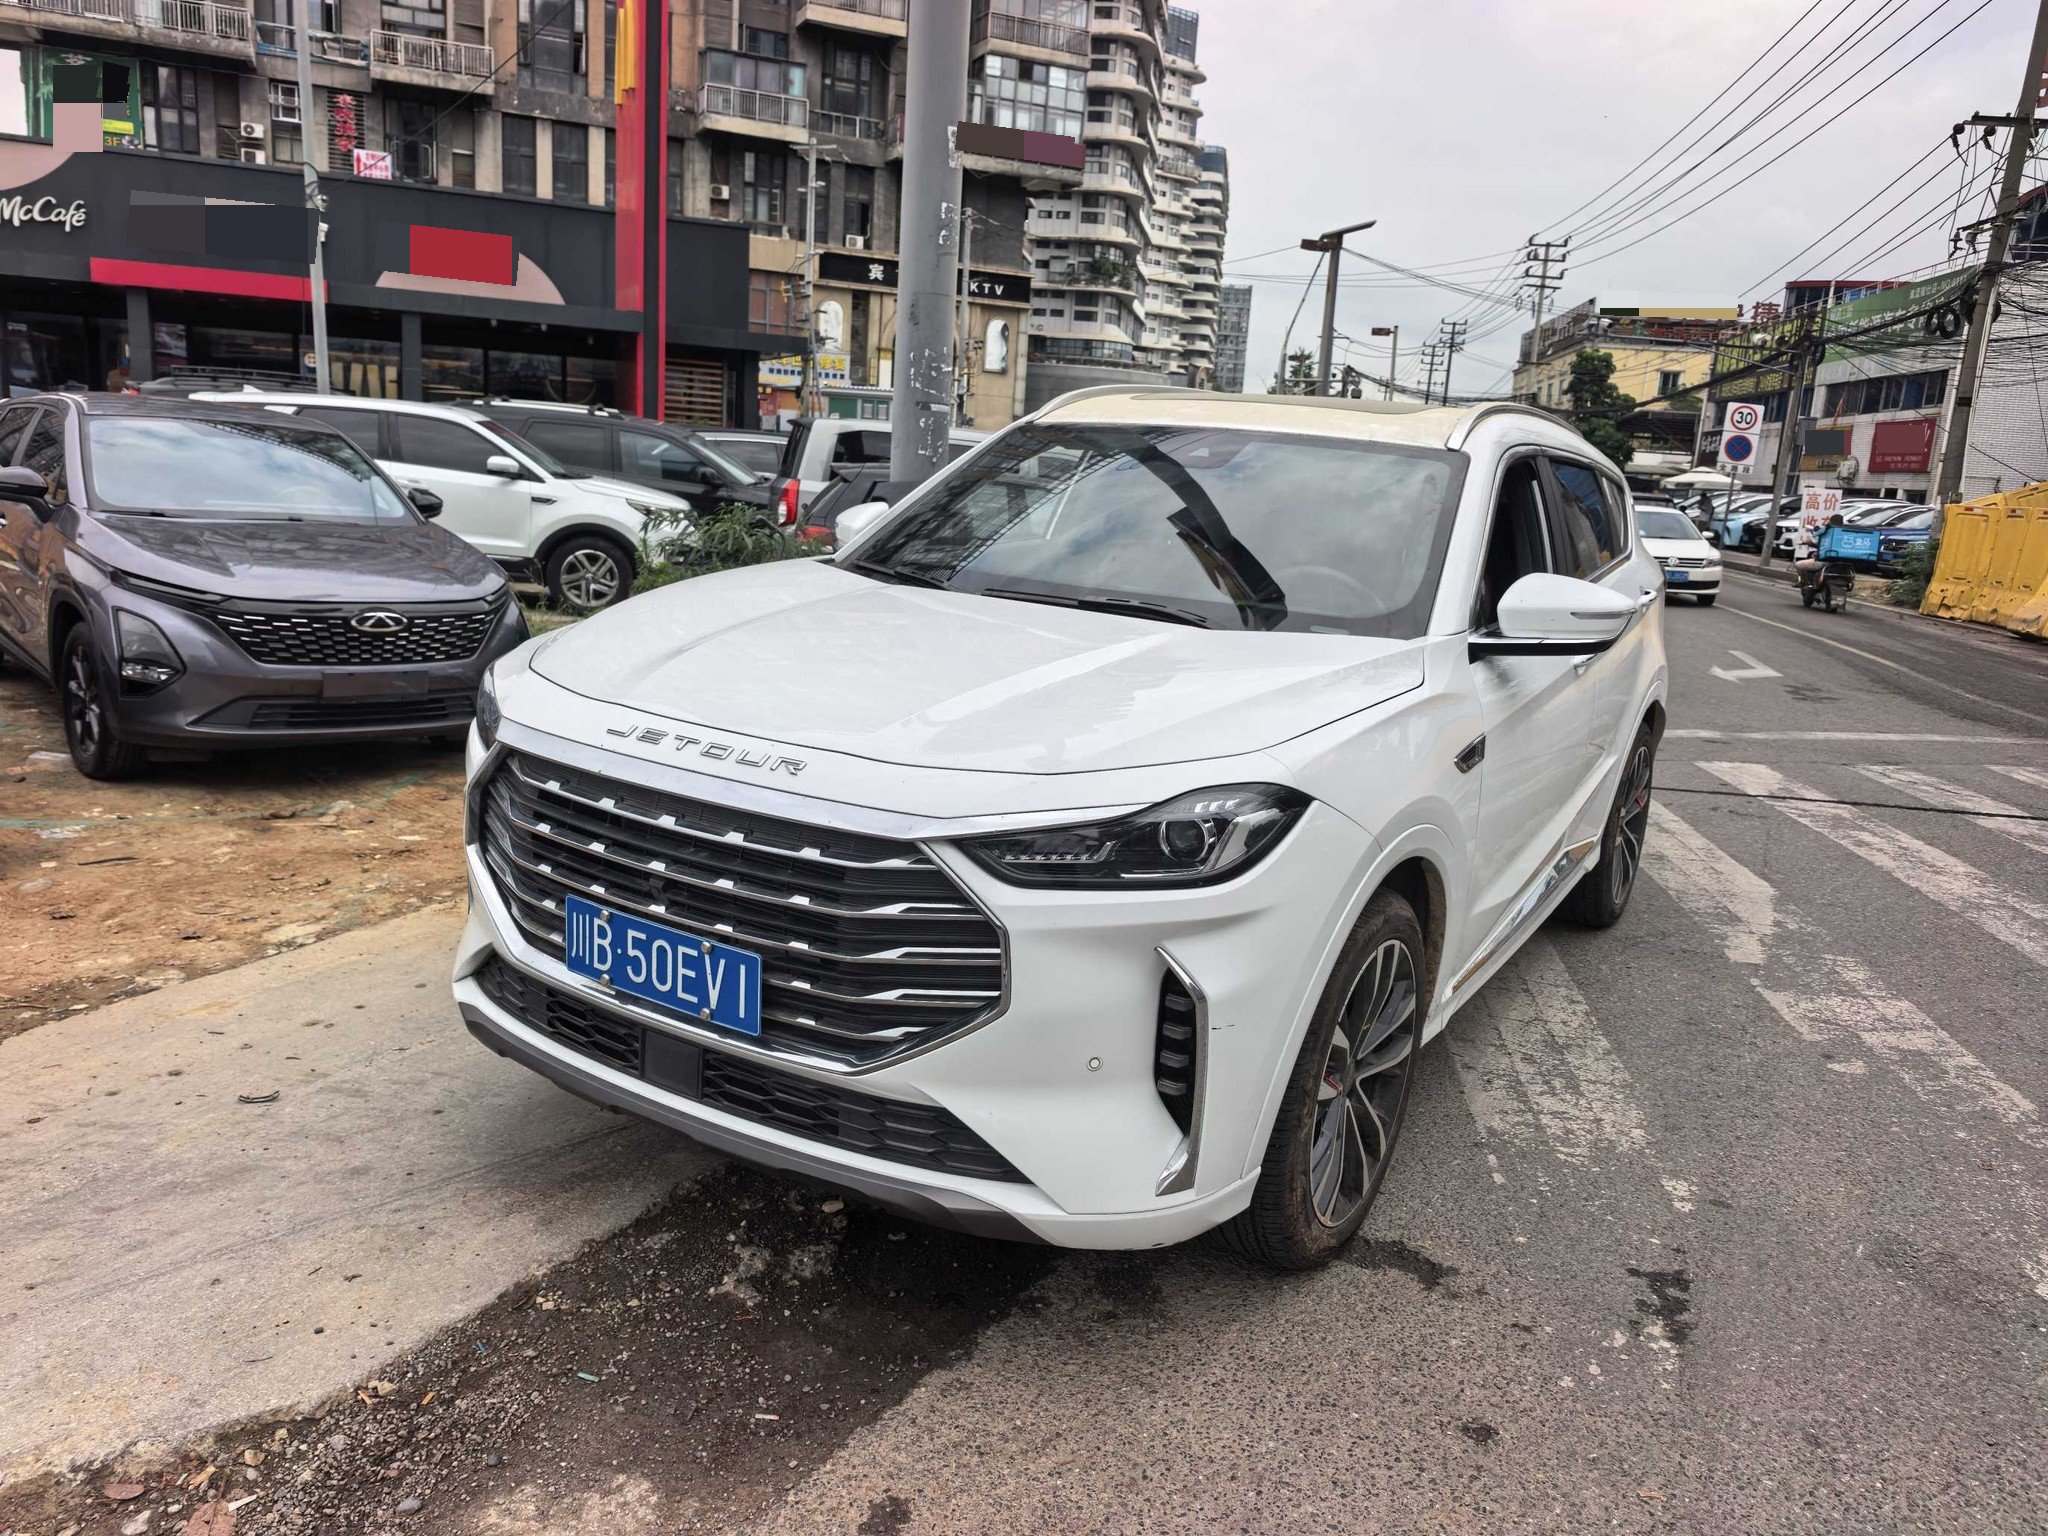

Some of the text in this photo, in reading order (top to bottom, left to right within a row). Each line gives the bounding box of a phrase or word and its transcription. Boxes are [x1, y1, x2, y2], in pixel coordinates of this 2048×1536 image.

[104, 136, 121, 146] 3F
[0, 195, 87, 232] McCafé
[969, 282, 1004, 296] KTV
[1735, 411, 1753, 425] 30
[1806, 492, 1839, 511] 高价
[606, 724, 807, 776] JETOUR
